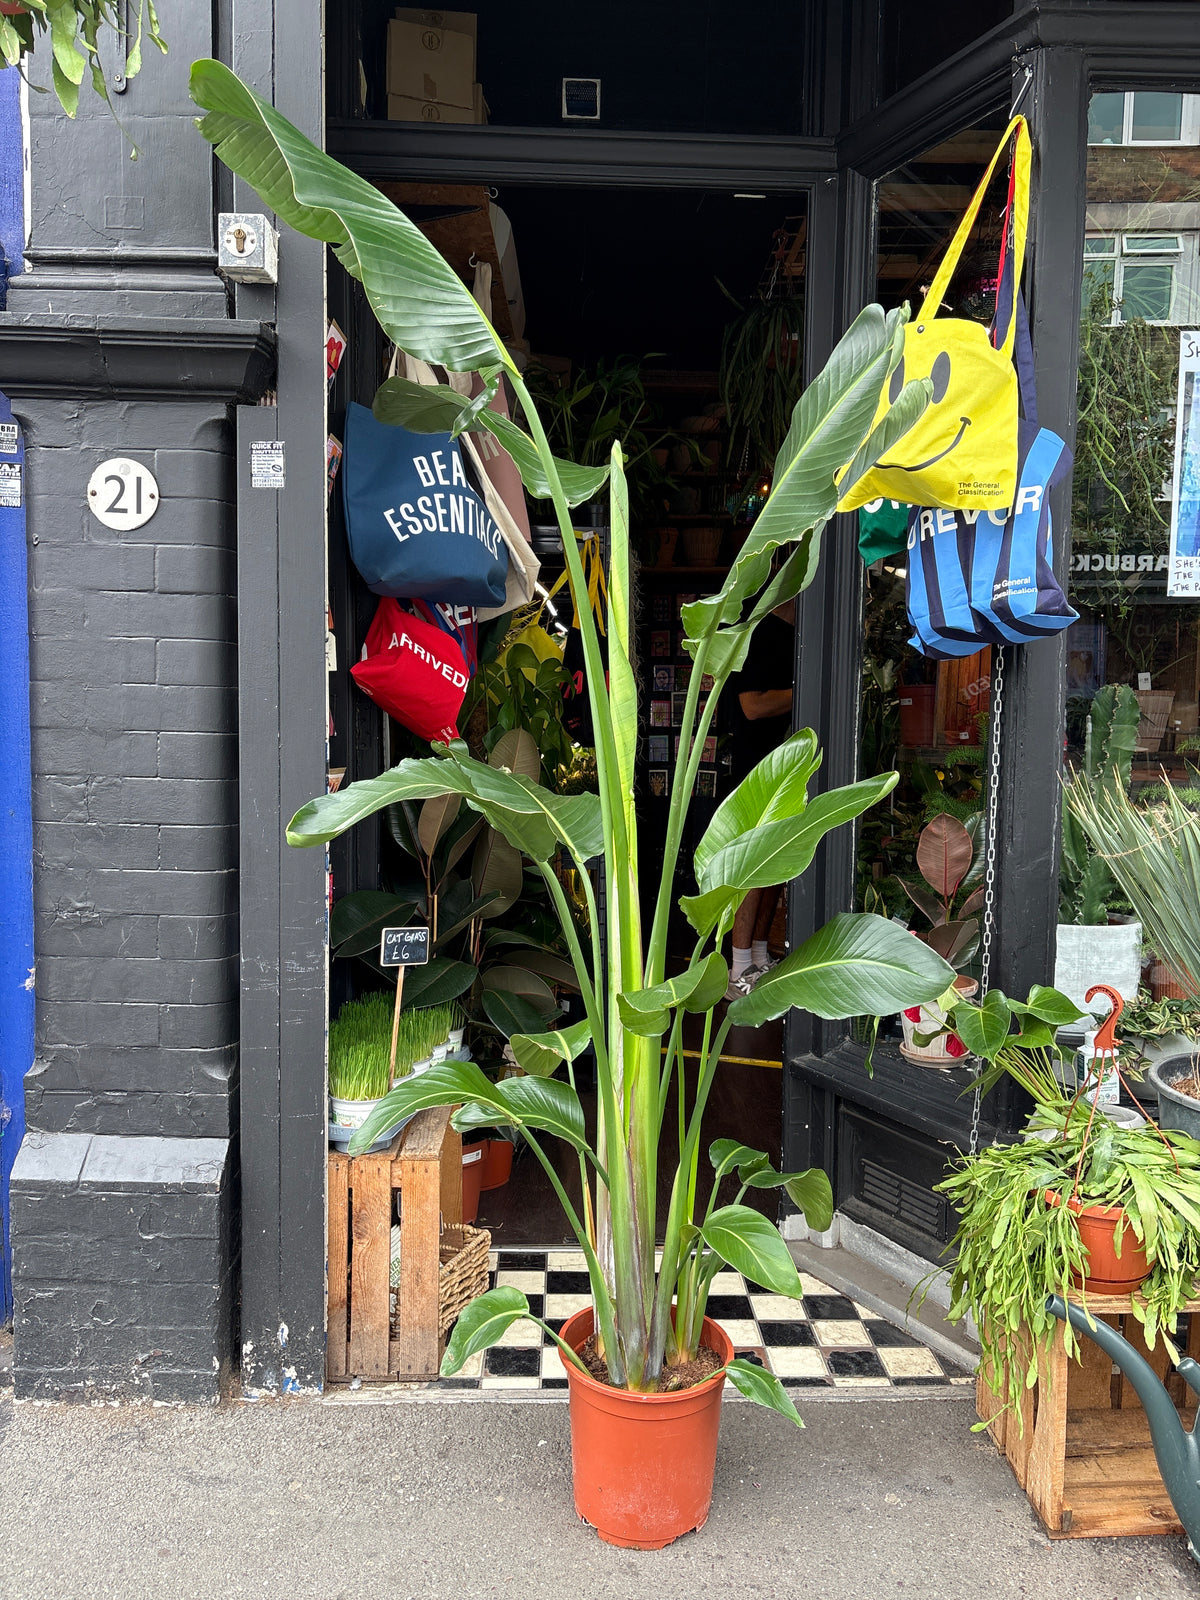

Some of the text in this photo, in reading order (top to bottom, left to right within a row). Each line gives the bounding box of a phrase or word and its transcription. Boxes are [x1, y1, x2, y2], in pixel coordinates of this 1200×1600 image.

[412, 450, 475, 488] BEA
[972, 481, 1000, 489] General
[104, 474, 142, 515] 21
[1173, 571, 1193, 580] THE
[1002, 576, 1031, 588] General
[1173, 582, 1190, 592] THE
[387, 932, 404, 944] CAT
[392, 945, 409, 959] £6
